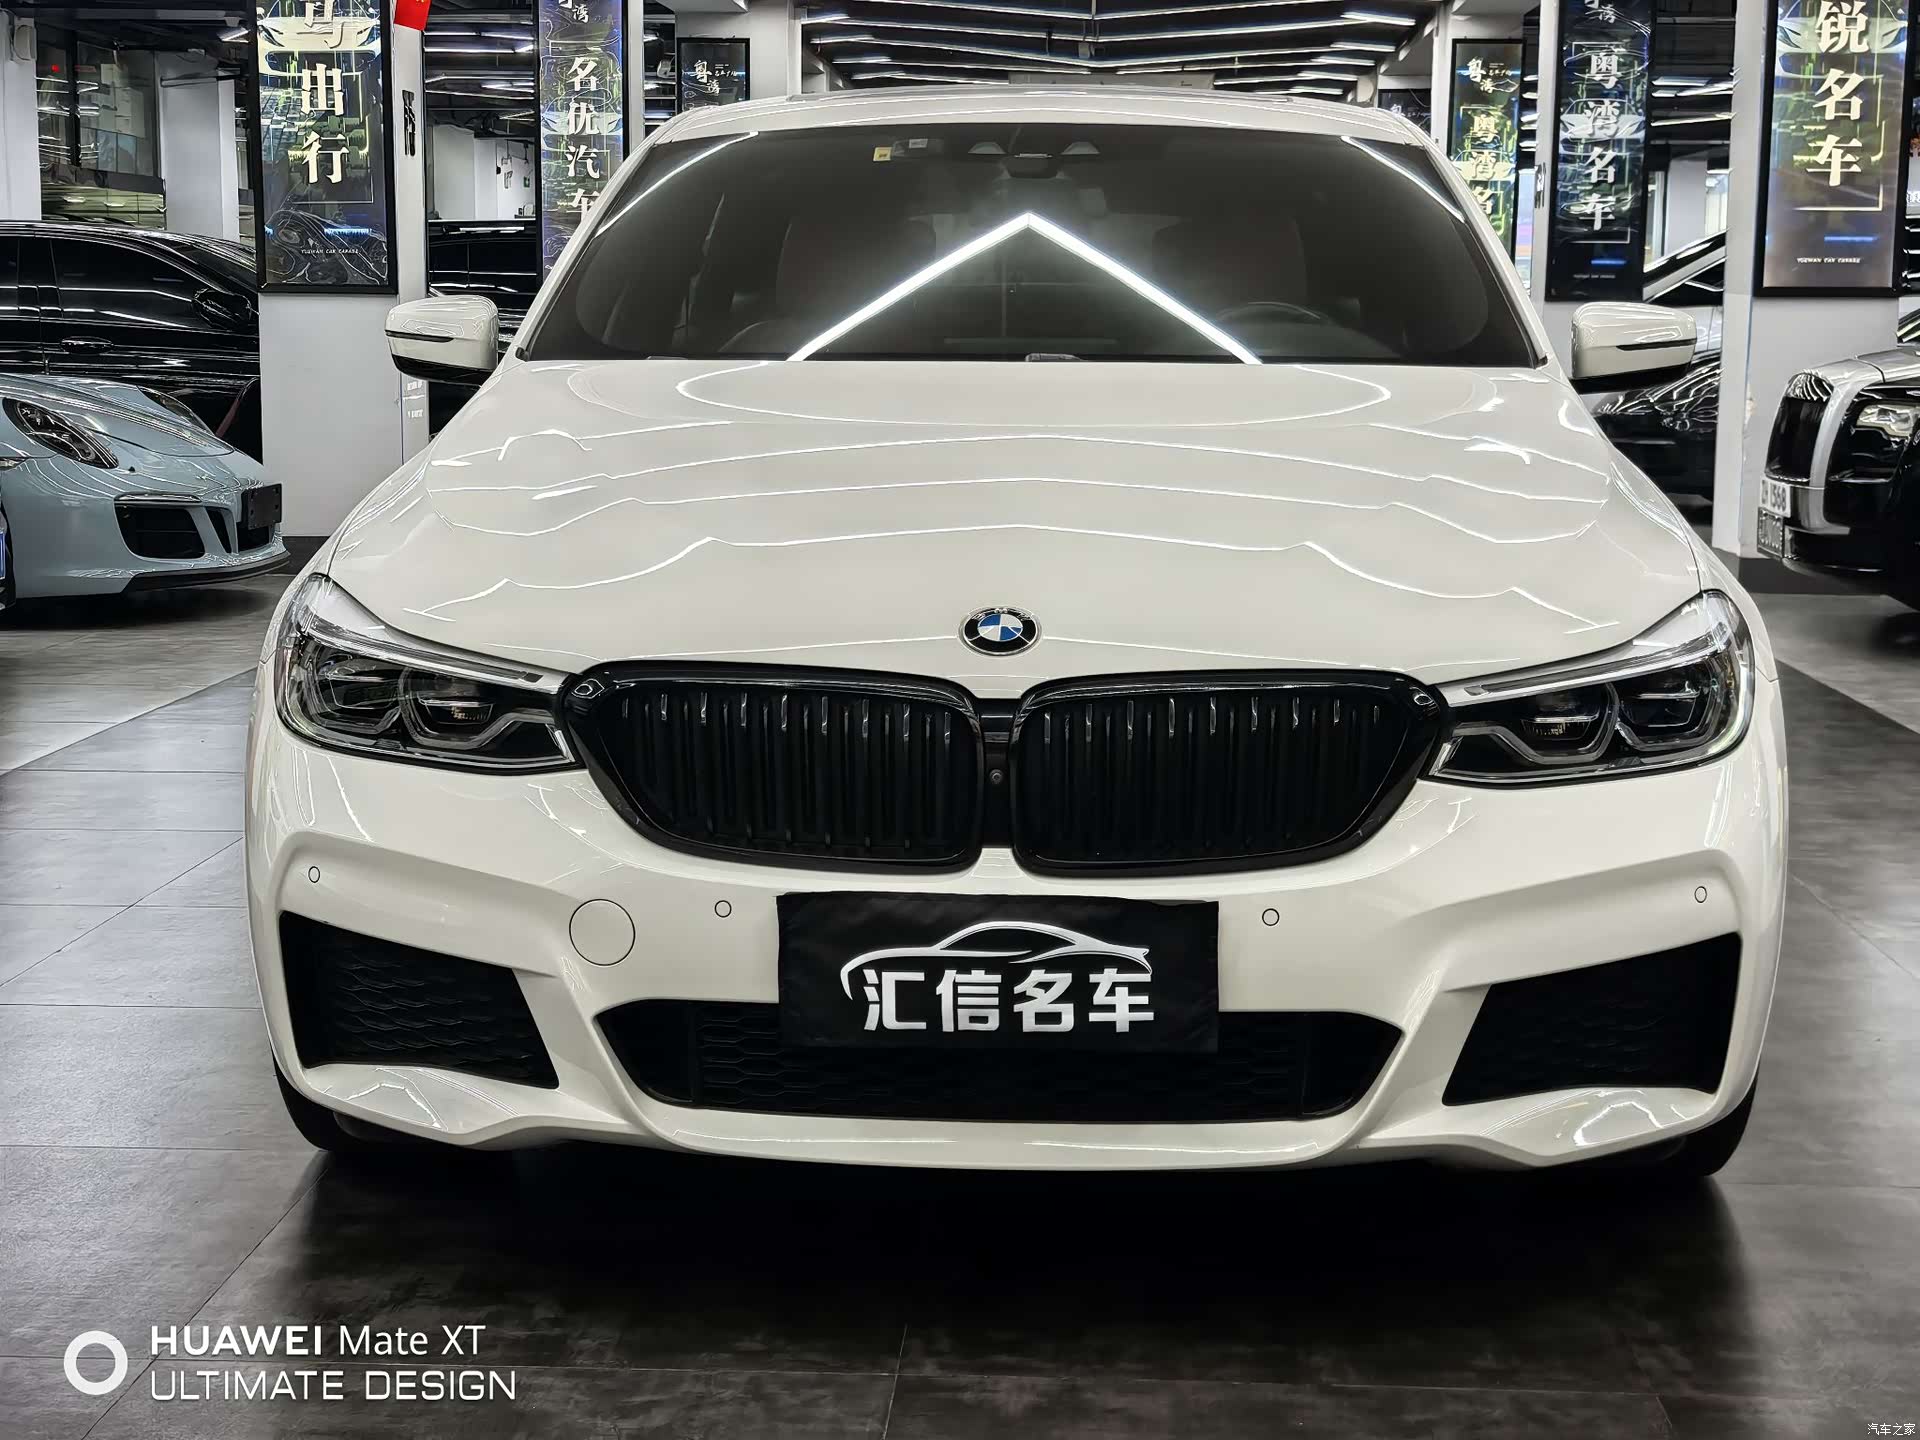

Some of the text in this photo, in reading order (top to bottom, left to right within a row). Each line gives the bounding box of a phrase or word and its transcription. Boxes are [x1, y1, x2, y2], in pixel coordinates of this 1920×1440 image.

[1579, 52, 1620, 231] 粤湾名车
[1805, 0, 1869, 187] 锐名车
[863, 968, 1154, 1032] 汇信名车
